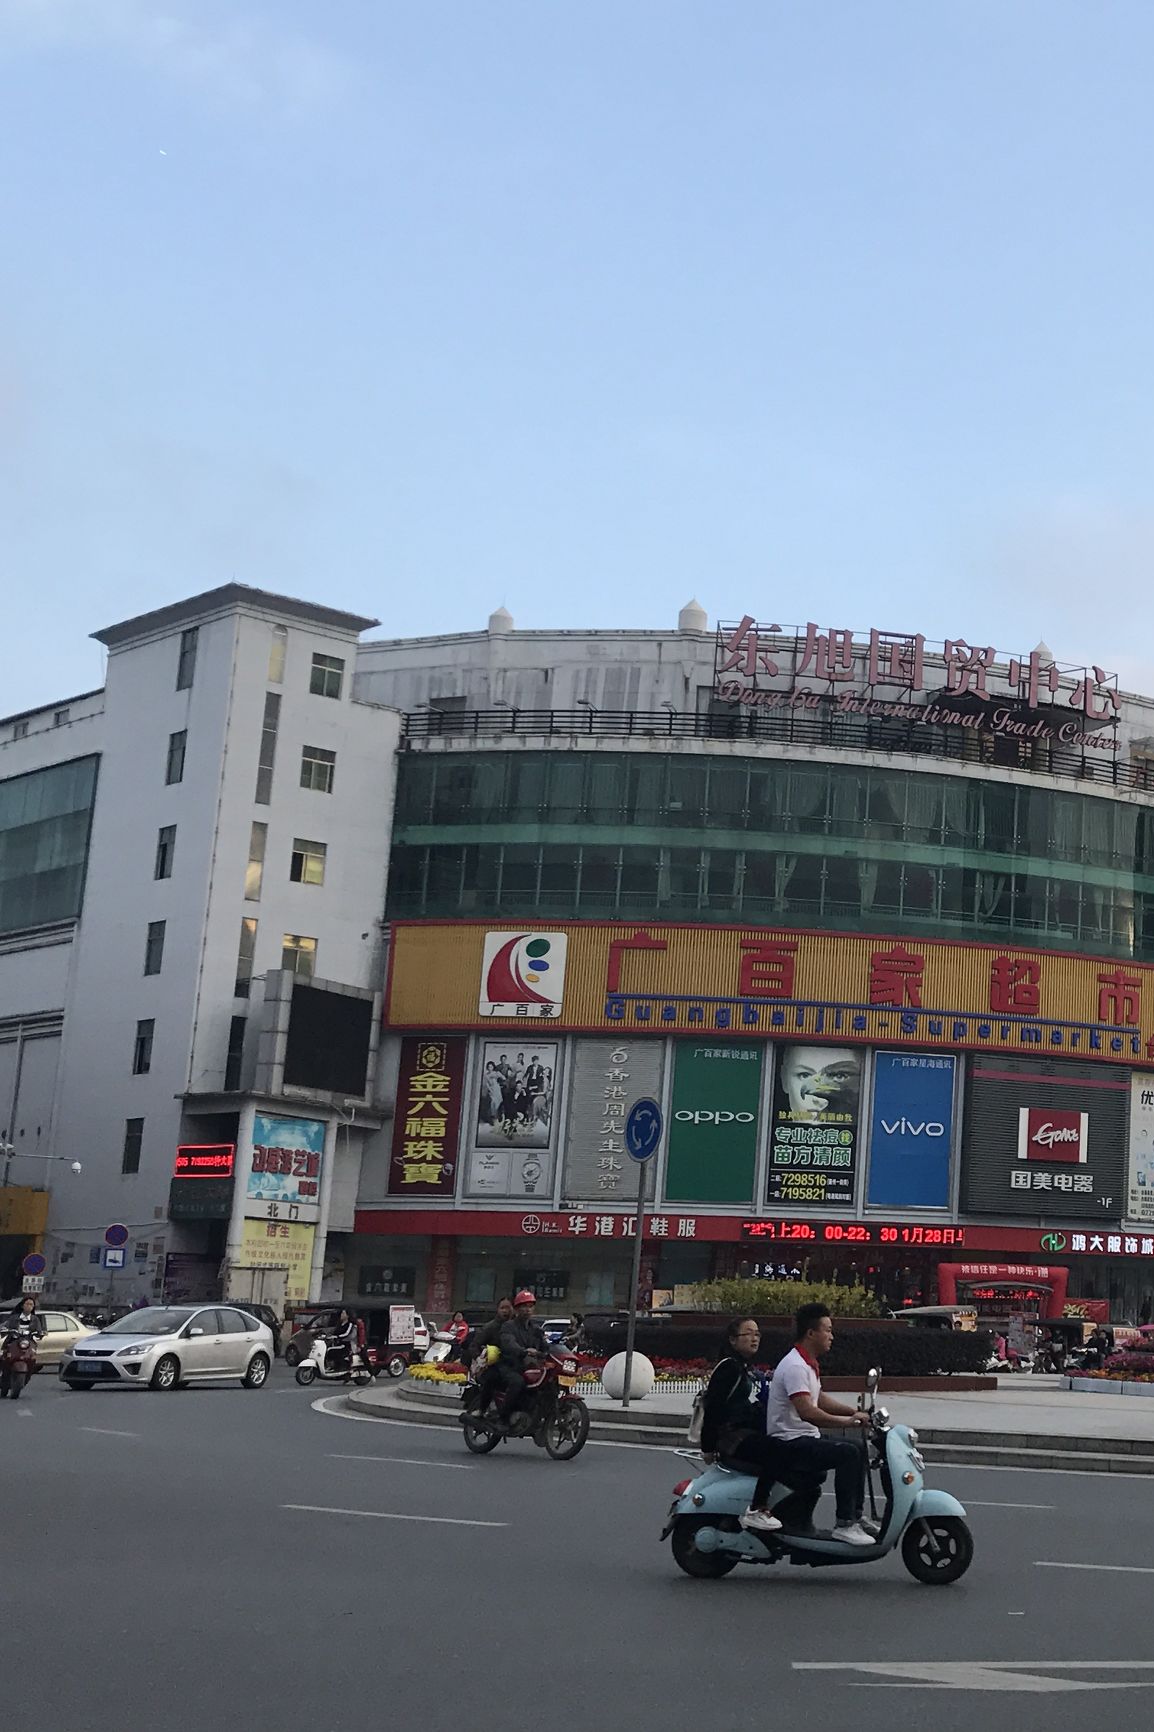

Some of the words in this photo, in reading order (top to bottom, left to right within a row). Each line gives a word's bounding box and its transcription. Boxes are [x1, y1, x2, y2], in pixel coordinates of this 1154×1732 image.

[720, 615, 1122, 720] 东旭国贸中心
[837, 689, 985, 730] International
[990, 707, 1054, 738] Trade
[607, 931, 1143, 1026] 广百家超市
[490, 1003, 554, 1017] 广百家
[880, 1117, 944, 1137] vivo
[774, 1145, 852, 1166] 苗方清颜
[781, 1173, 827, 1186] 7298516
[1010, 1171, 1094, 1193] 国美电器
[780, 1187, 826, 1200] 7195821
[268, 1203, 299, 1220] 北门
[568, 1215, 696, 1238] 华港汇鞋服
[1072, 1233, 1154, 1255] 鸿大服饰城
